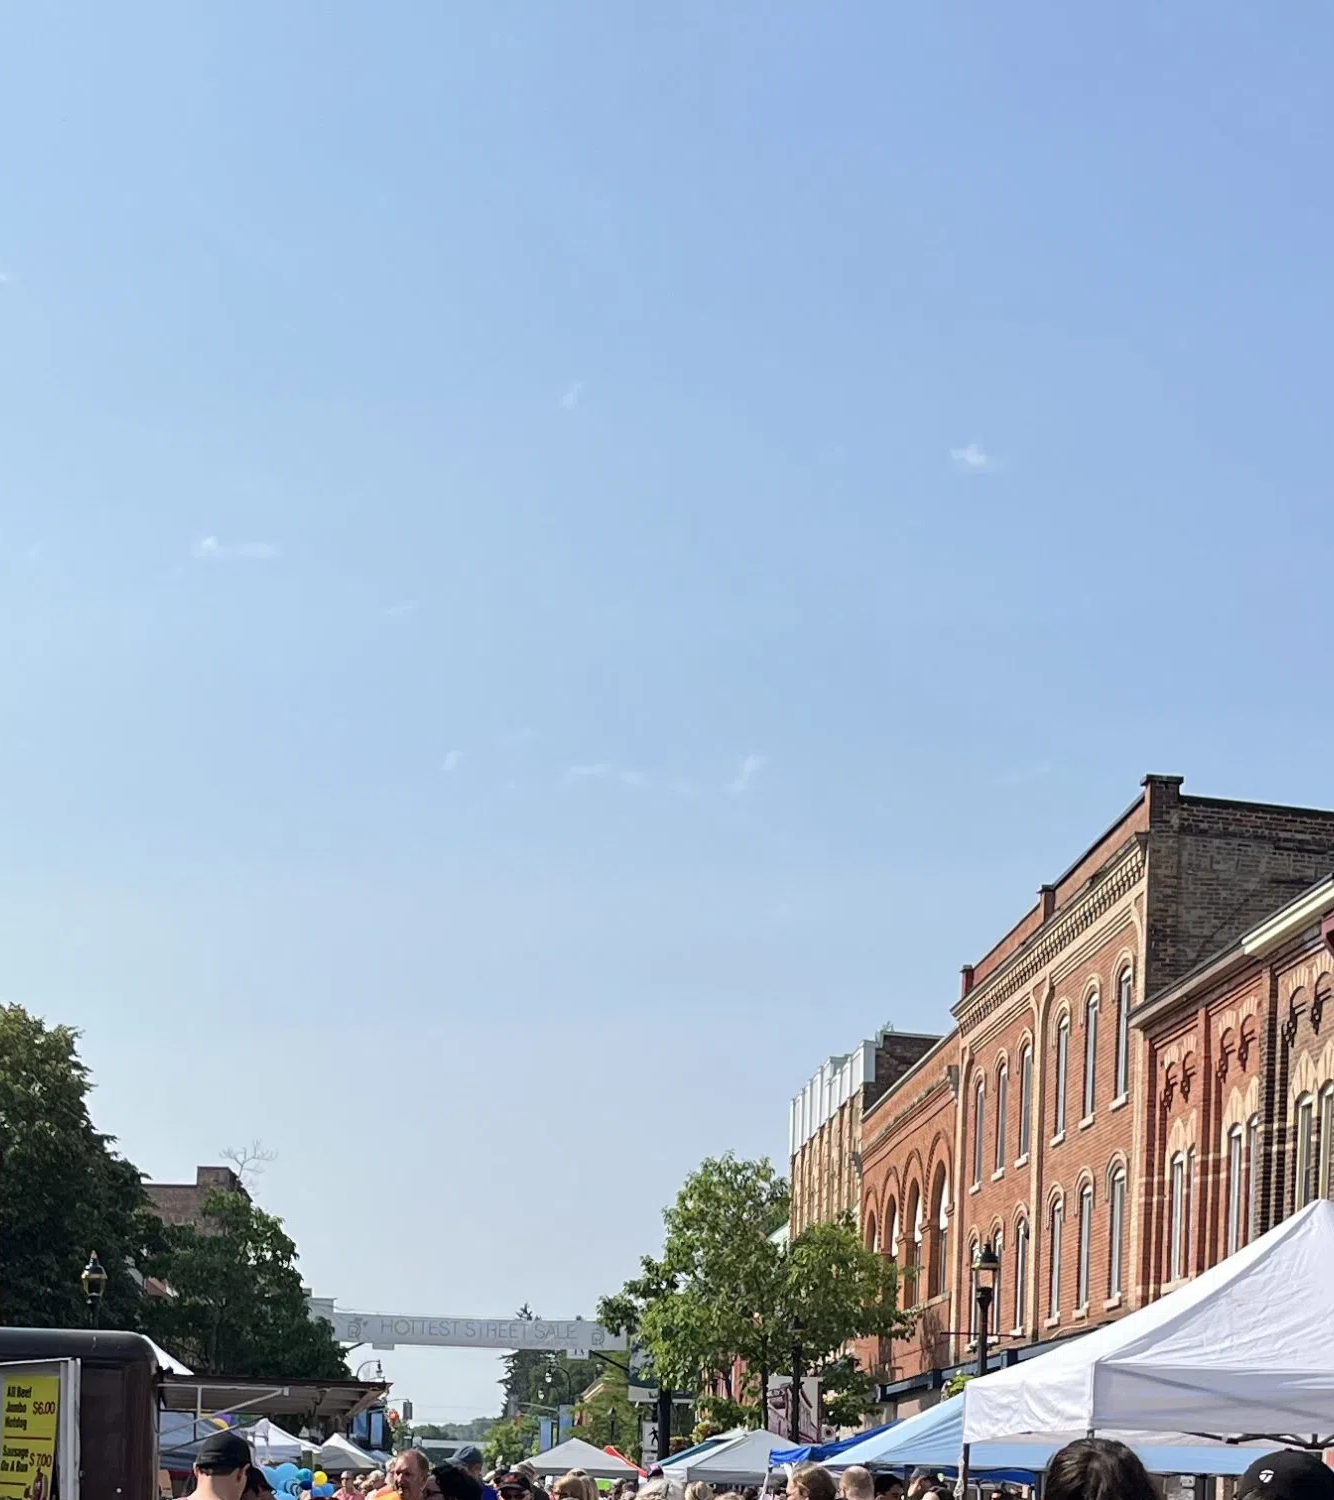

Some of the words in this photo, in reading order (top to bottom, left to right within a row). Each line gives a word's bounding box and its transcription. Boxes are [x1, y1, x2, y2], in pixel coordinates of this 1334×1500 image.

[380, 1318, 460, 1337] HOTTEST
[465, 1320, 529, 1340] STREET
[534, 1322, 578, 1340] SALE
[17, 1386, 32, 1398] Beef
[32, 1401, 55, 1415] $6.00
[2, 1444, 29, 1459] Sausage
